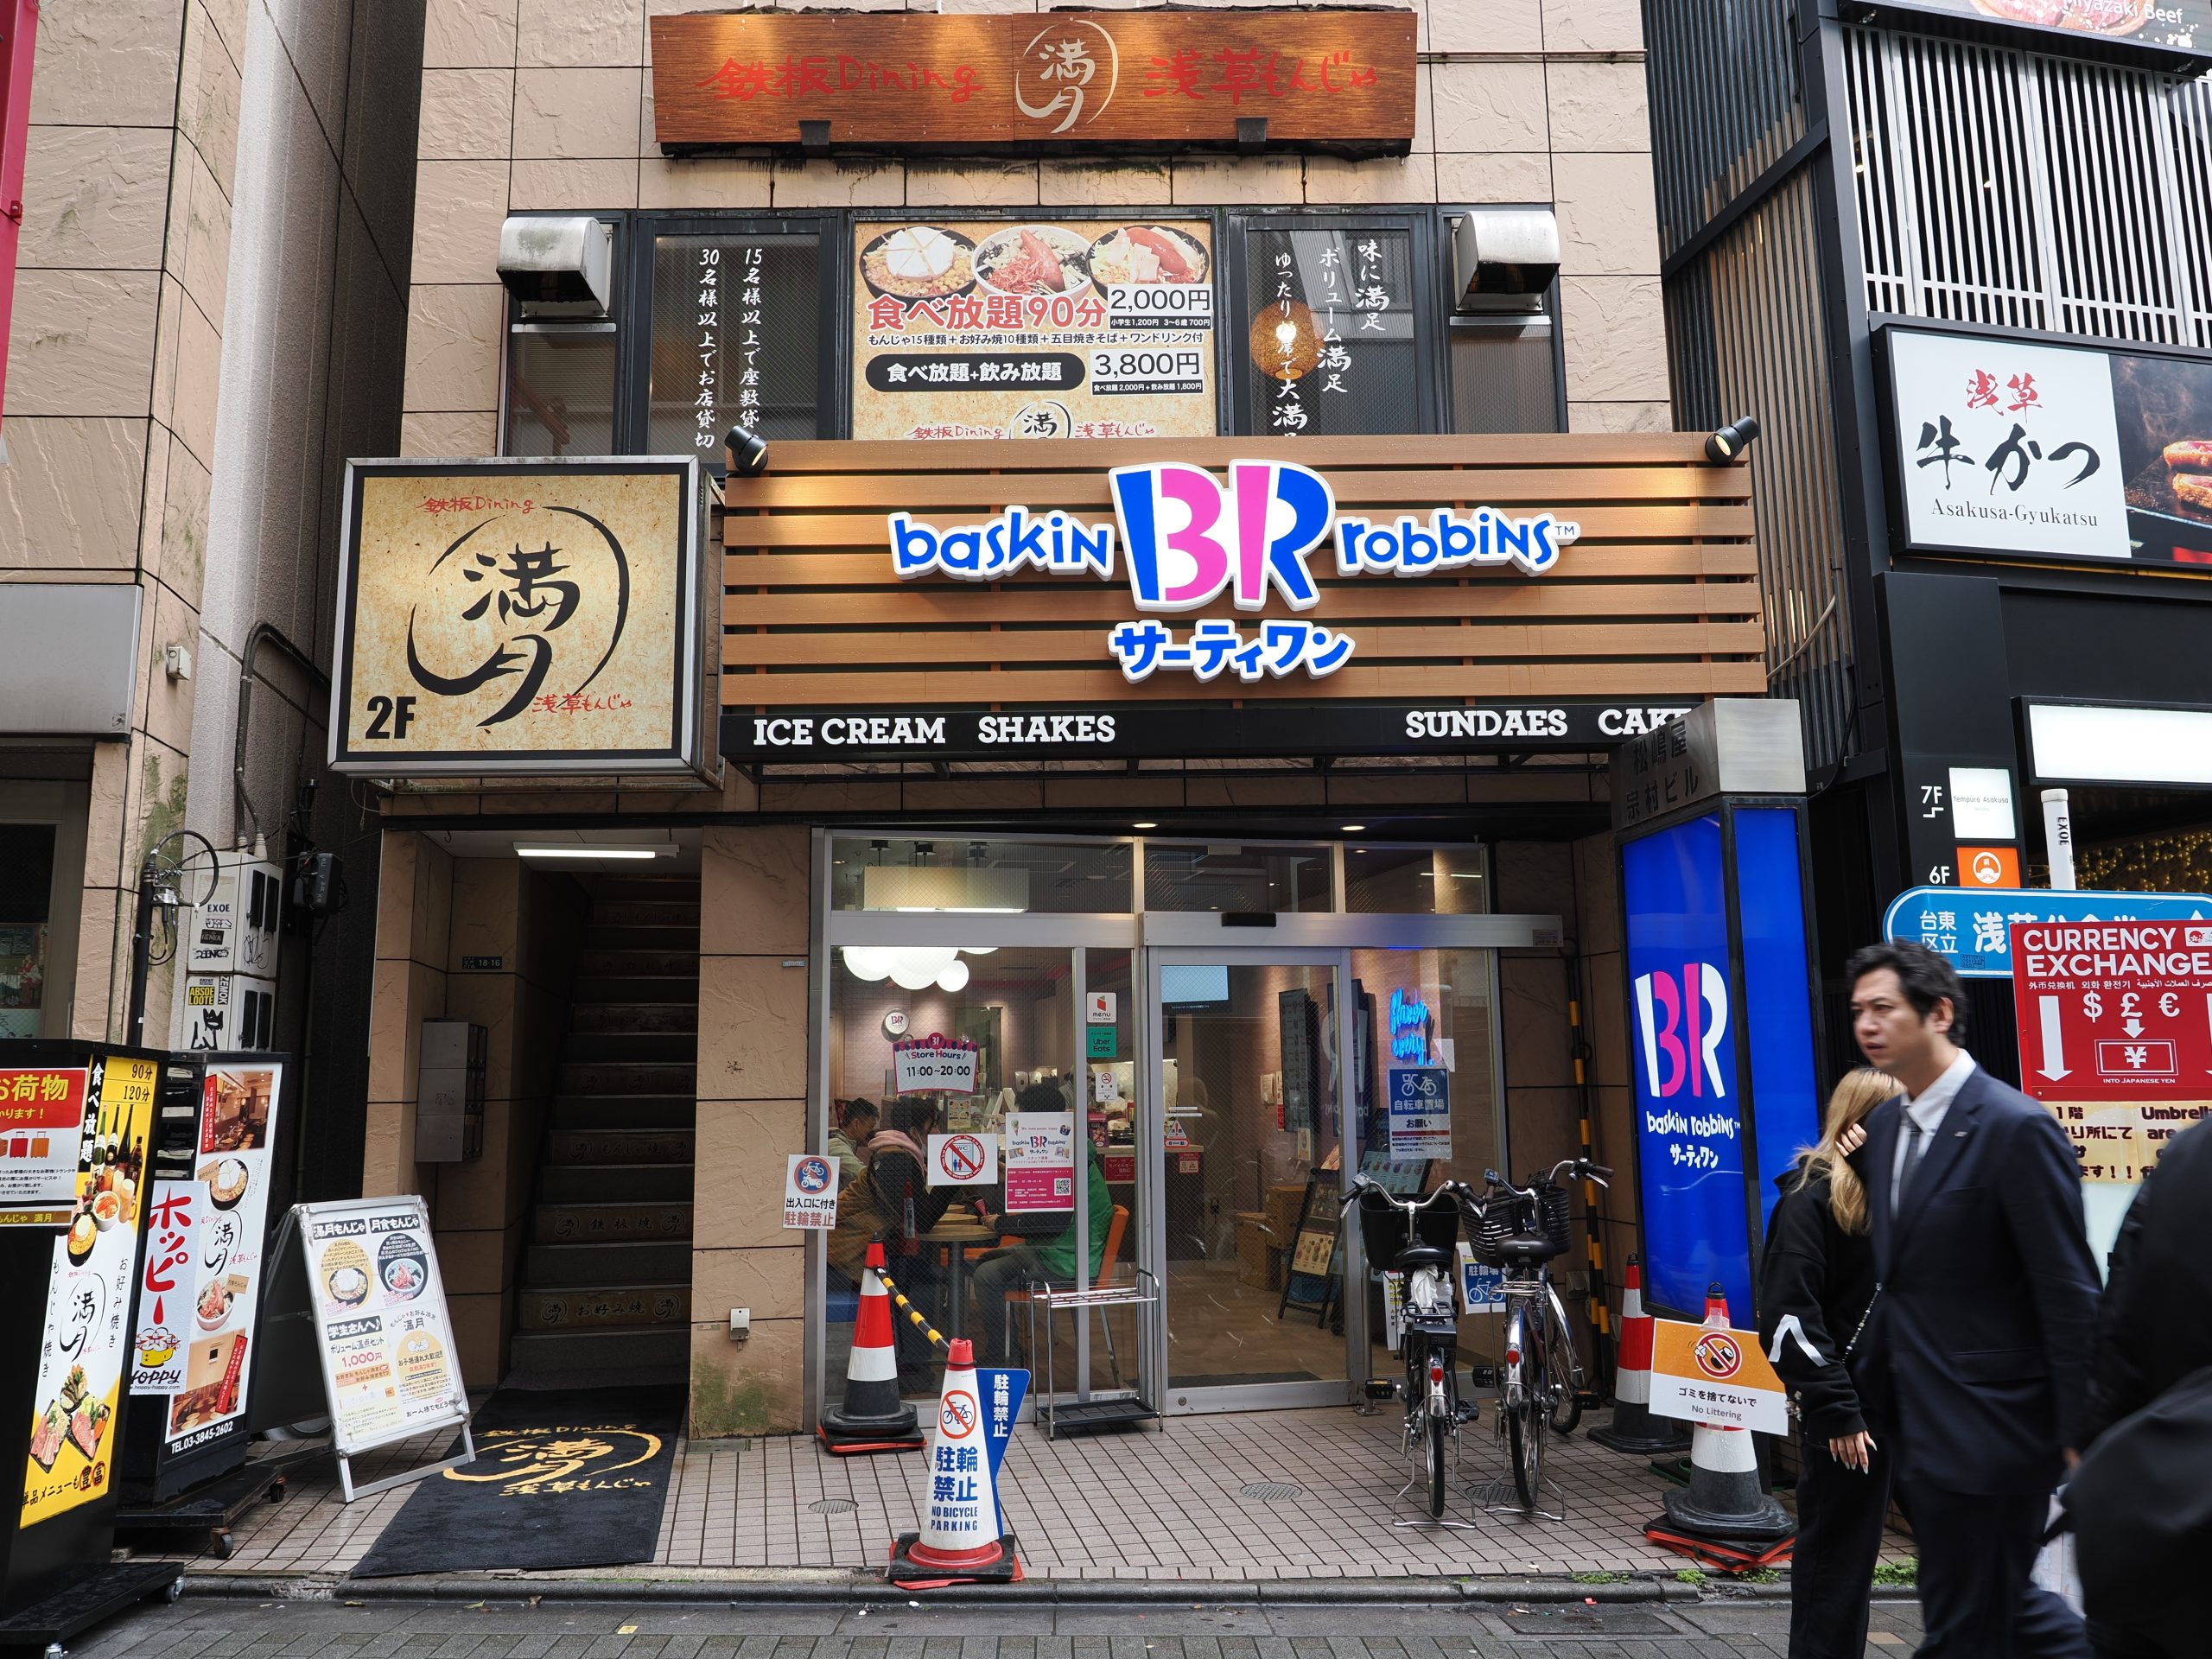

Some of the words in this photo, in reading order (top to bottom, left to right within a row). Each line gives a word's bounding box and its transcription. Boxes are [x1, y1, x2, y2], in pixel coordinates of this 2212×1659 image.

[2144, 3, 2183, 24] Beef
[696, 54, 983, 103] 鉄板Dining
[1143, 48, 1380, 105] 浅草もんじゃ
[1355, 238, 1390, 331] 味に満足
[1110, 289, 1211, 313] 2,000円
[868, 295, 1107, 331] 食べ放題90分
[1316, 246, 1351, 393] ボリューム満足
[694, 248, 721, 448] 30名様以上でお店貸切
[739, 248, 763, 439] 15名様以上で座敷貸
[1094, 353, 1200, 378] 3,800円
[1966, 368, 2044, 424] 浅草
[1074, 423, 1155, 439] 浅草もんじゃ
[1916, 414, 2101, 496] 牛かつ
[416, 496, 538, 515] 鉄板Dining
[1931, 498, 2099, 527] Asakusa-Gyukatsu
[1113, 462, 1333, 605] BR
[1111, 622, 1352, 679] サーティワン
[531, 693, 632, 715] 浅草もんじゃ
[365, 695, 417, 740] 2F
[753, 718, 814, 747] ICE
[821, 716, 946, 746] CREAM
[977, 715, 1116, 744] SHAKES
[1405, 709, 1568, 739] SUNDAES
[1598, 708, 1692, 736] CAK
[1921, 785, 1942, 805] 7F
[1929, 866, 1951, 885] 6F
[207, 904, 230, 912] EXOE
[1919, 910, 1957, 931] 台東
[2024, 926, 2177, 952] CURRENCY
[2026, 952, 2212, 978] EXCHANGE
[188, 996, 214, 1006] LOOTE
[1635, 963, 1728, 1099] BR
[911, 1051, 935, 1059] Store
[935, 1050, 961, 1059] Hours
[131, 1064, 153, 1080] 90分
[123, 1085, 151, 1103] 120分
[1394, 1098, 1446, 1111] 自転車置場
[79, 1061, 105, 1163] 食べ放題
[1406, 1118, 1432, 1128] お願い
[1029, 1135, 1048, 1148] BR
[1669, 1143, 1719, 1169] サーティワン
[785, 1197, 836, 1210] 出入口に付き
[33, 1213, 53, 1223] 満月
[371, 1216, 420, 1231] 月食もんじゃ
[784, 1211, 835, 1227] 駐輪禁止
[145, 1185, 193, 1325] ホッピー
[403, 1317, 425, 1332] 満月
[341, 1351, 383, 1368] 1,000円
[993, 1373, 1010, 1438] 駐輪禁止
[1678, 1387, 1758, 1408] ゴミを捨てないで
[1691, 1404, 1704, 1414] No
[1706, 1405, 1743, 1421] Littering
[934, 1445, 979, 1473] 駐輪
[933, 1475, 979, 1503] 禁止
[931, 1505, 943, 1518] NO
[943, 1505, 979, 1518] BICYCLE
[931, 1519, 979, 1531] PARKING
